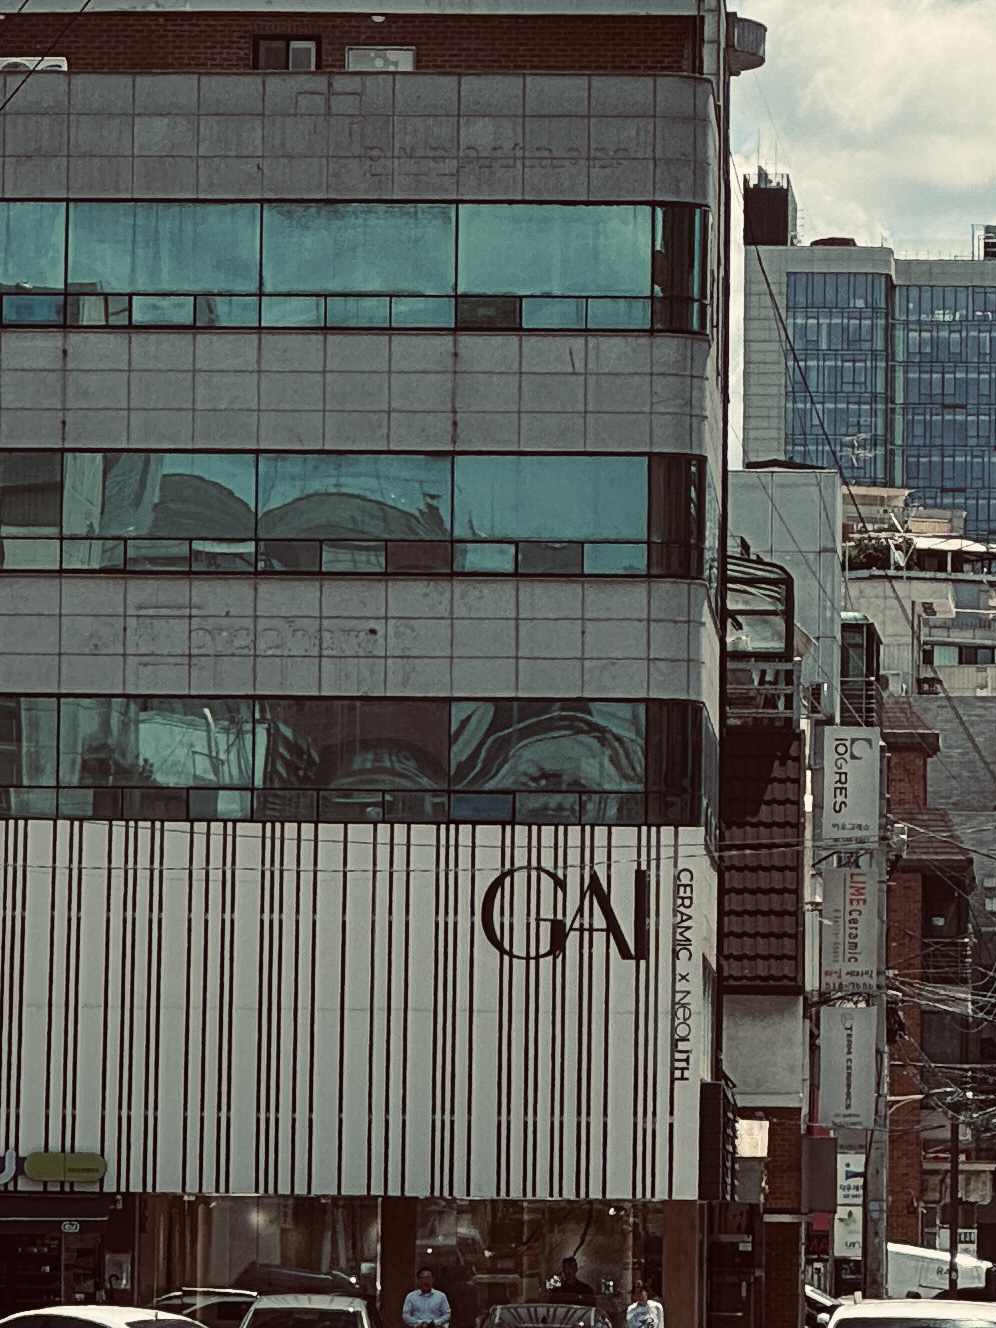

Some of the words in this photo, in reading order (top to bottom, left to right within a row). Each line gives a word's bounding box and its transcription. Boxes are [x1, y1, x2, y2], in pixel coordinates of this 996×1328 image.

[675, 867, 694, 962] CERAMIC
[849, 872, 868, 907] LIME
[847, 909, 863, 964] Ceramic
